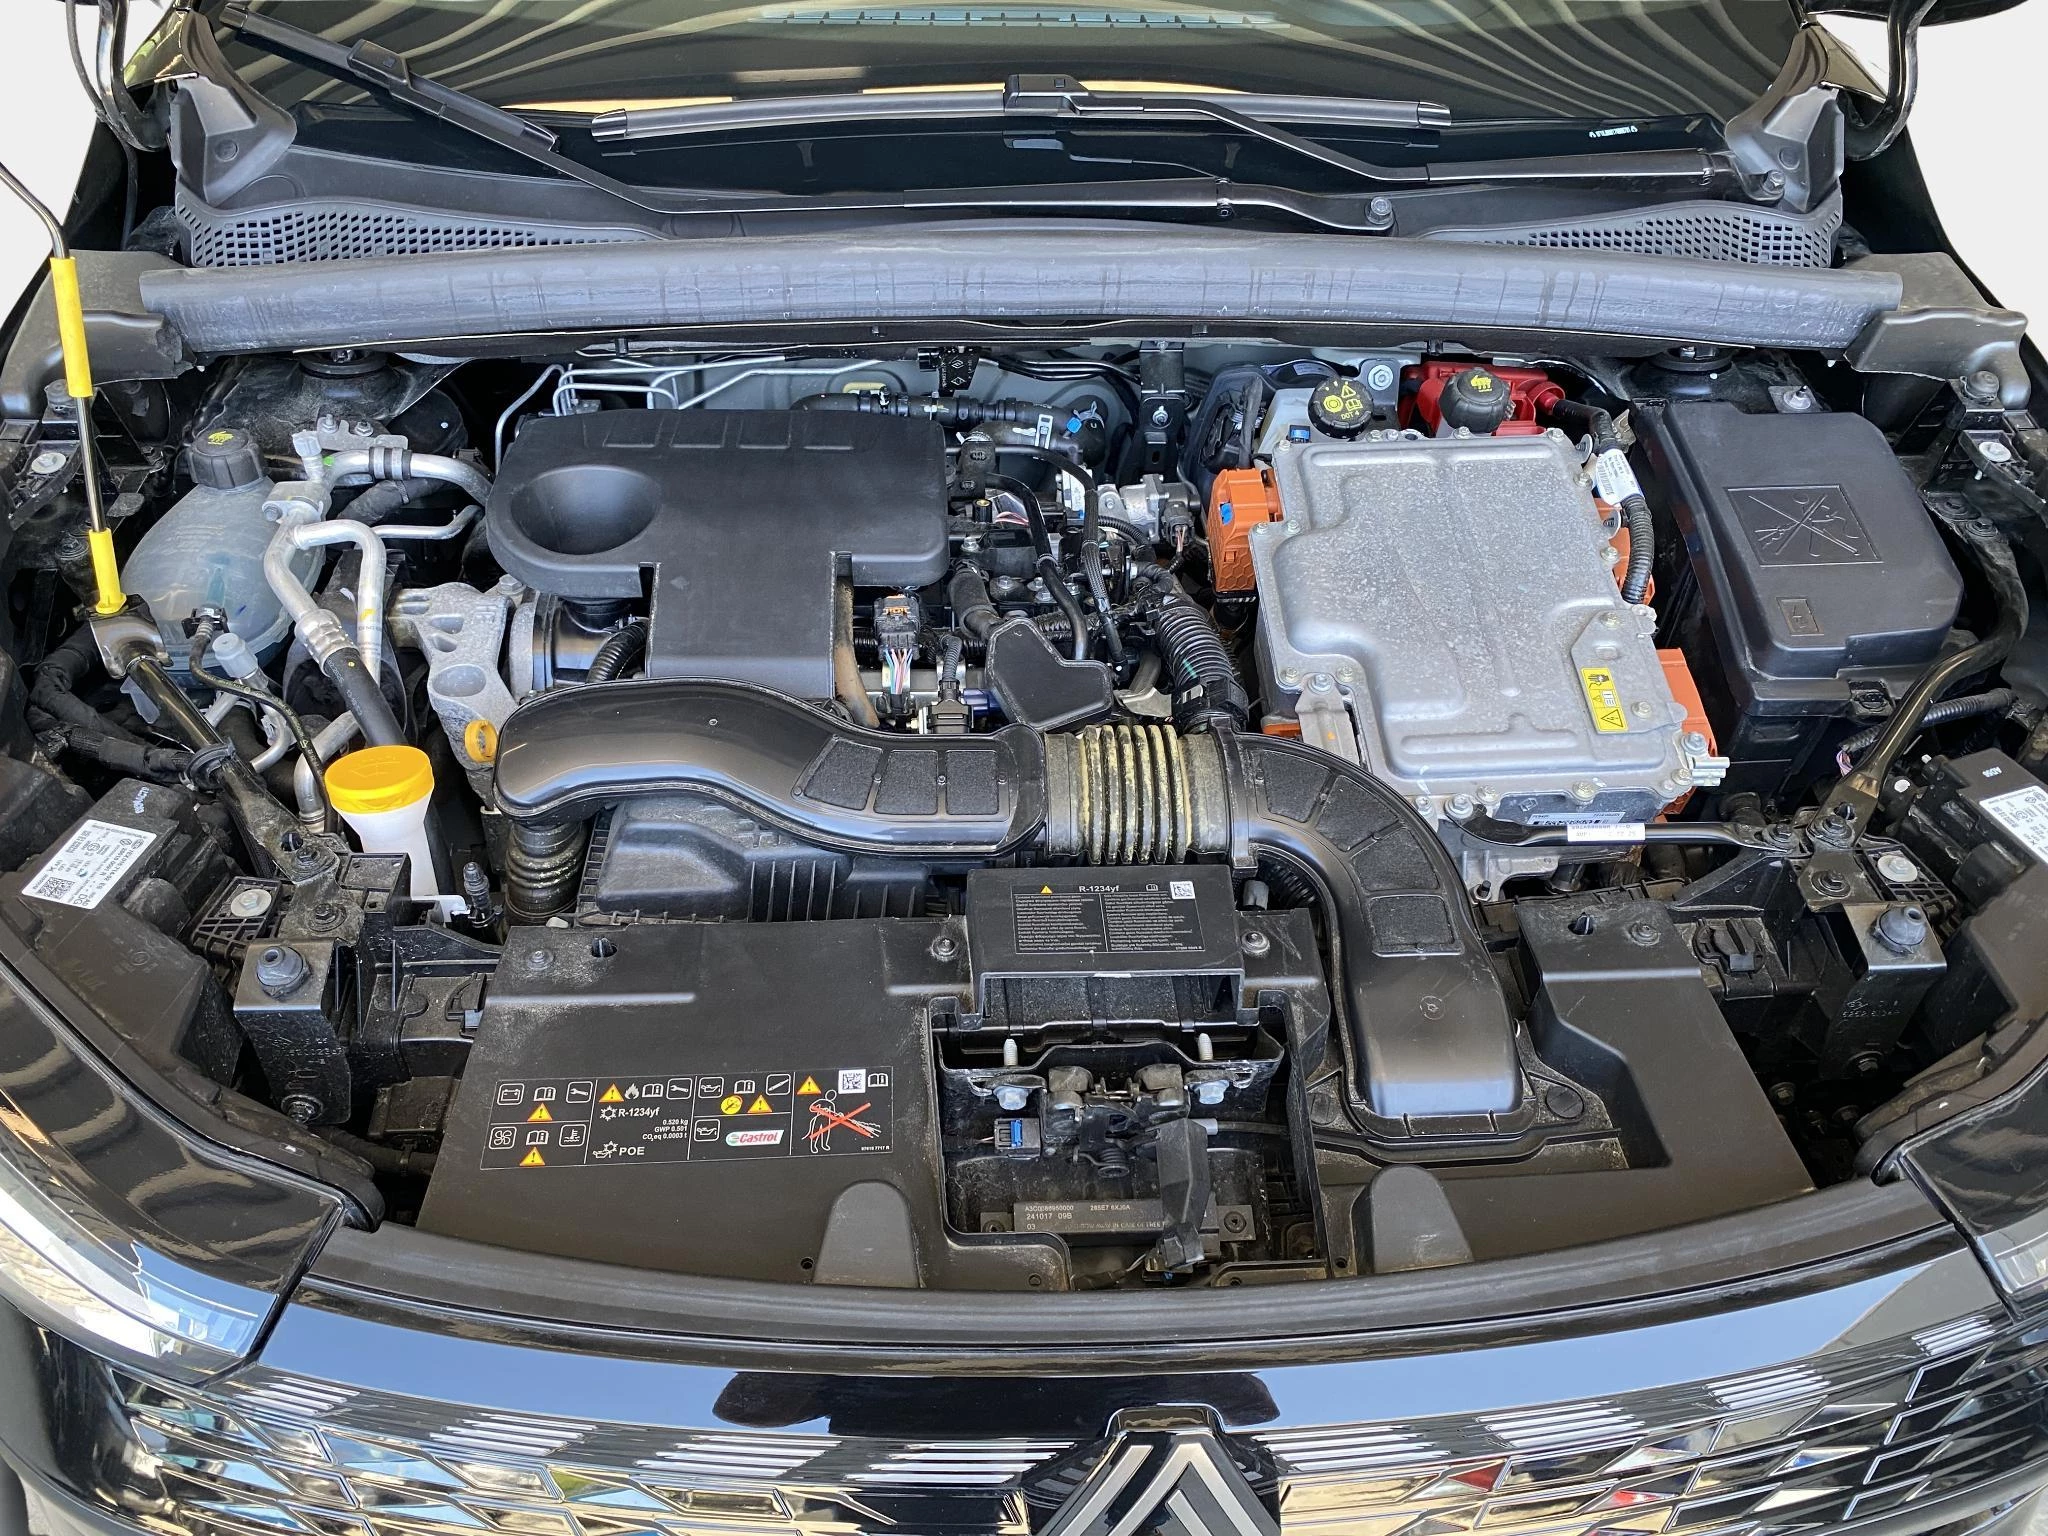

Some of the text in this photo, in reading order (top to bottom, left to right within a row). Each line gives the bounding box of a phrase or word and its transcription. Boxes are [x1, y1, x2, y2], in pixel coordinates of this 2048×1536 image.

[1341, 411, 1353, 420] DOT
[1078, 885, 1120, 893] R-1234yf
[618, 1107, 660, 1118] R-1234yf
[739, 1132, 779, 1144] Castrol
[618, 1146, 645, 1156] POE
[1026, 1212, 1053, 1220] 241017
